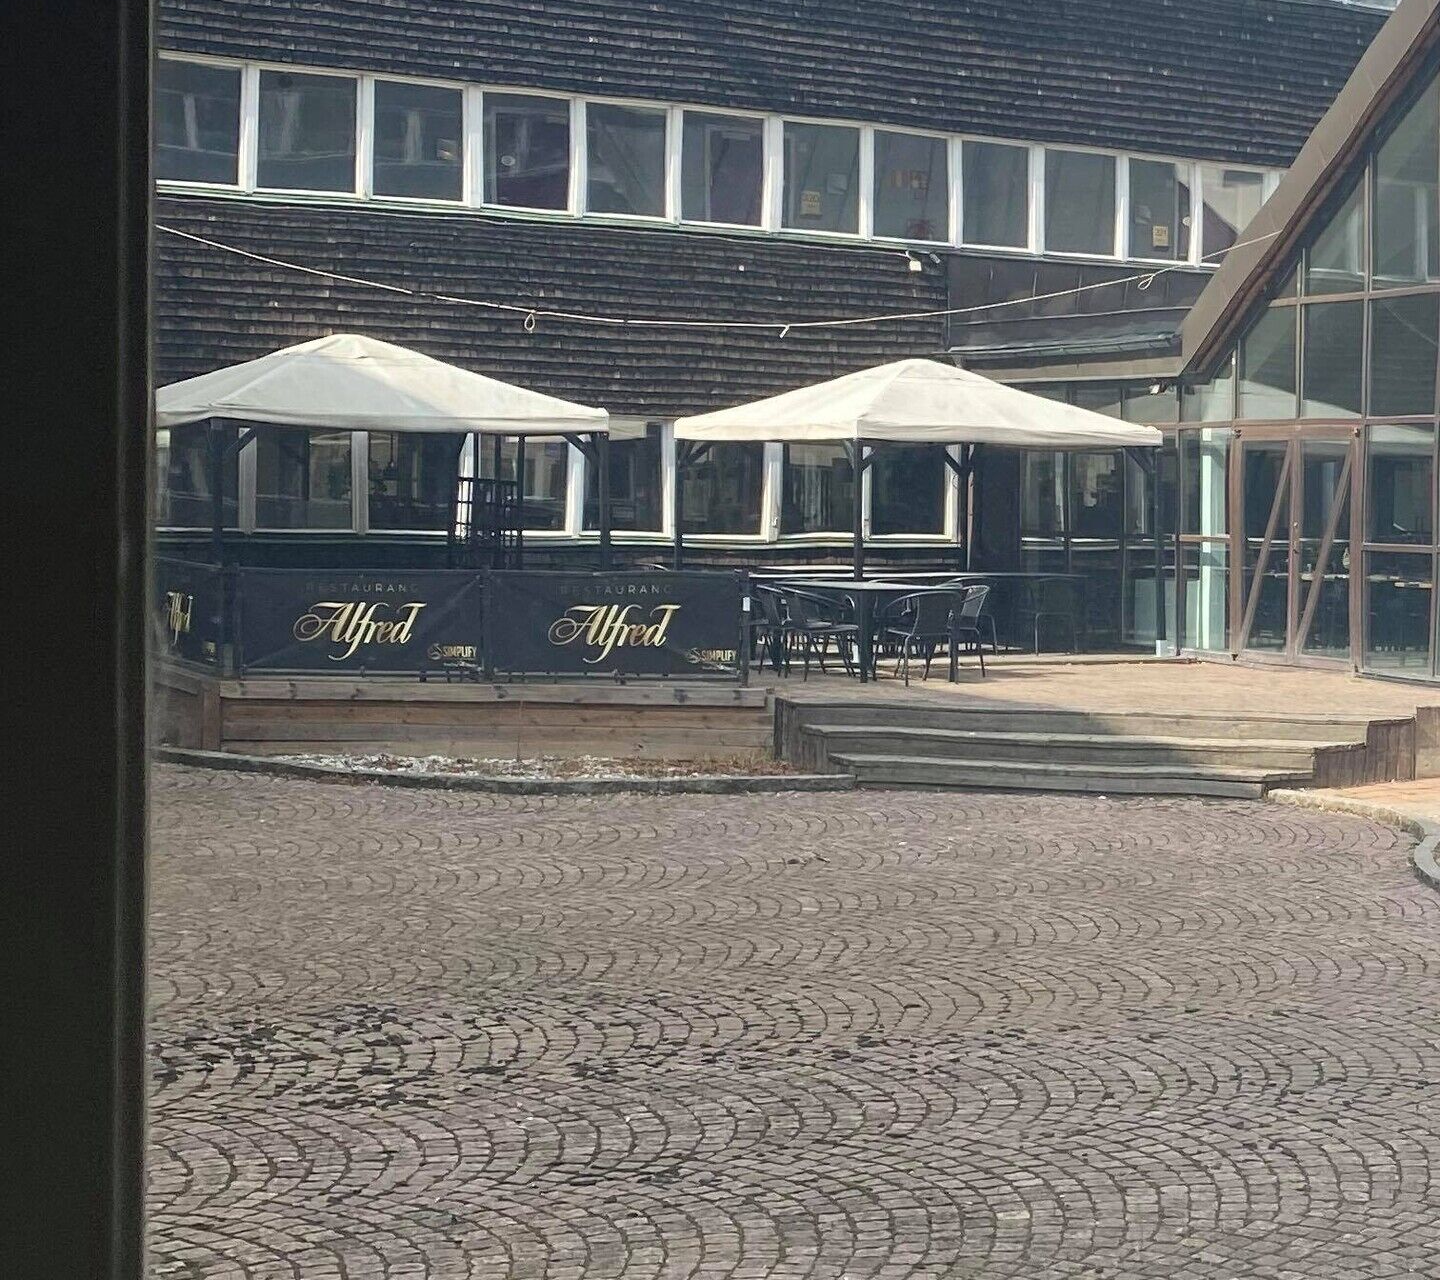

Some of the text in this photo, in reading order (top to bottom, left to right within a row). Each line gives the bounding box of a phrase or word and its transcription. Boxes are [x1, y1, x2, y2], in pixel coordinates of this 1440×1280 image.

[293, 601, 428, 661] Alfred
[548, 604, 682, 664] Alfred
[442, 645, 477, 658] SIMPLIFY
[701, 649, 737, 662] SIMPLIFY
